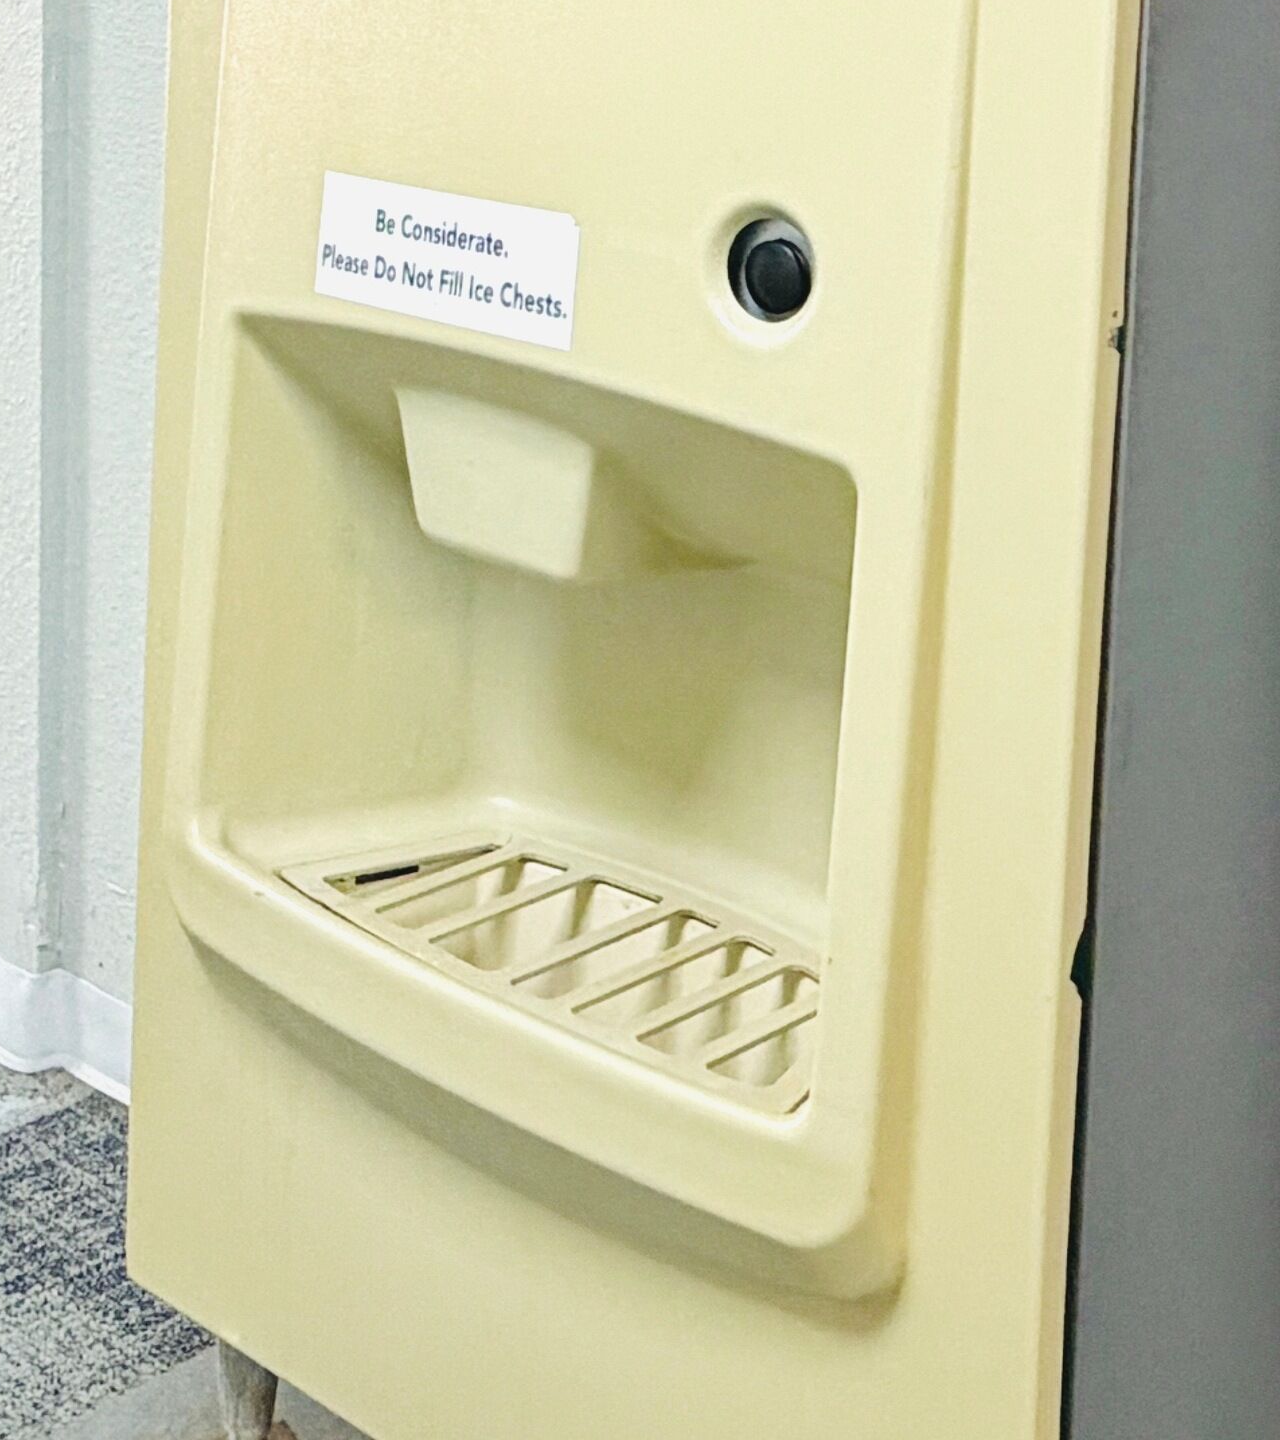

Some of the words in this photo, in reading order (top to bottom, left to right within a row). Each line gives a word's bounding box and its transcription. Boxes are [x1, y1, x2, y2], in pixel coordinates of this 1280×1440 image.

[375, 209, 395, 235] Be
[401, 214, 509, 258] Considerate.
[322, 243, 369, 276] Please
[374, 255, 396, 282] Do
[402, 261, 433, 291] Not
[438, 269, 464, 297] Fill
[469, 275, 494, 304] Ice
[500, 282, 568, 318] Chests.
